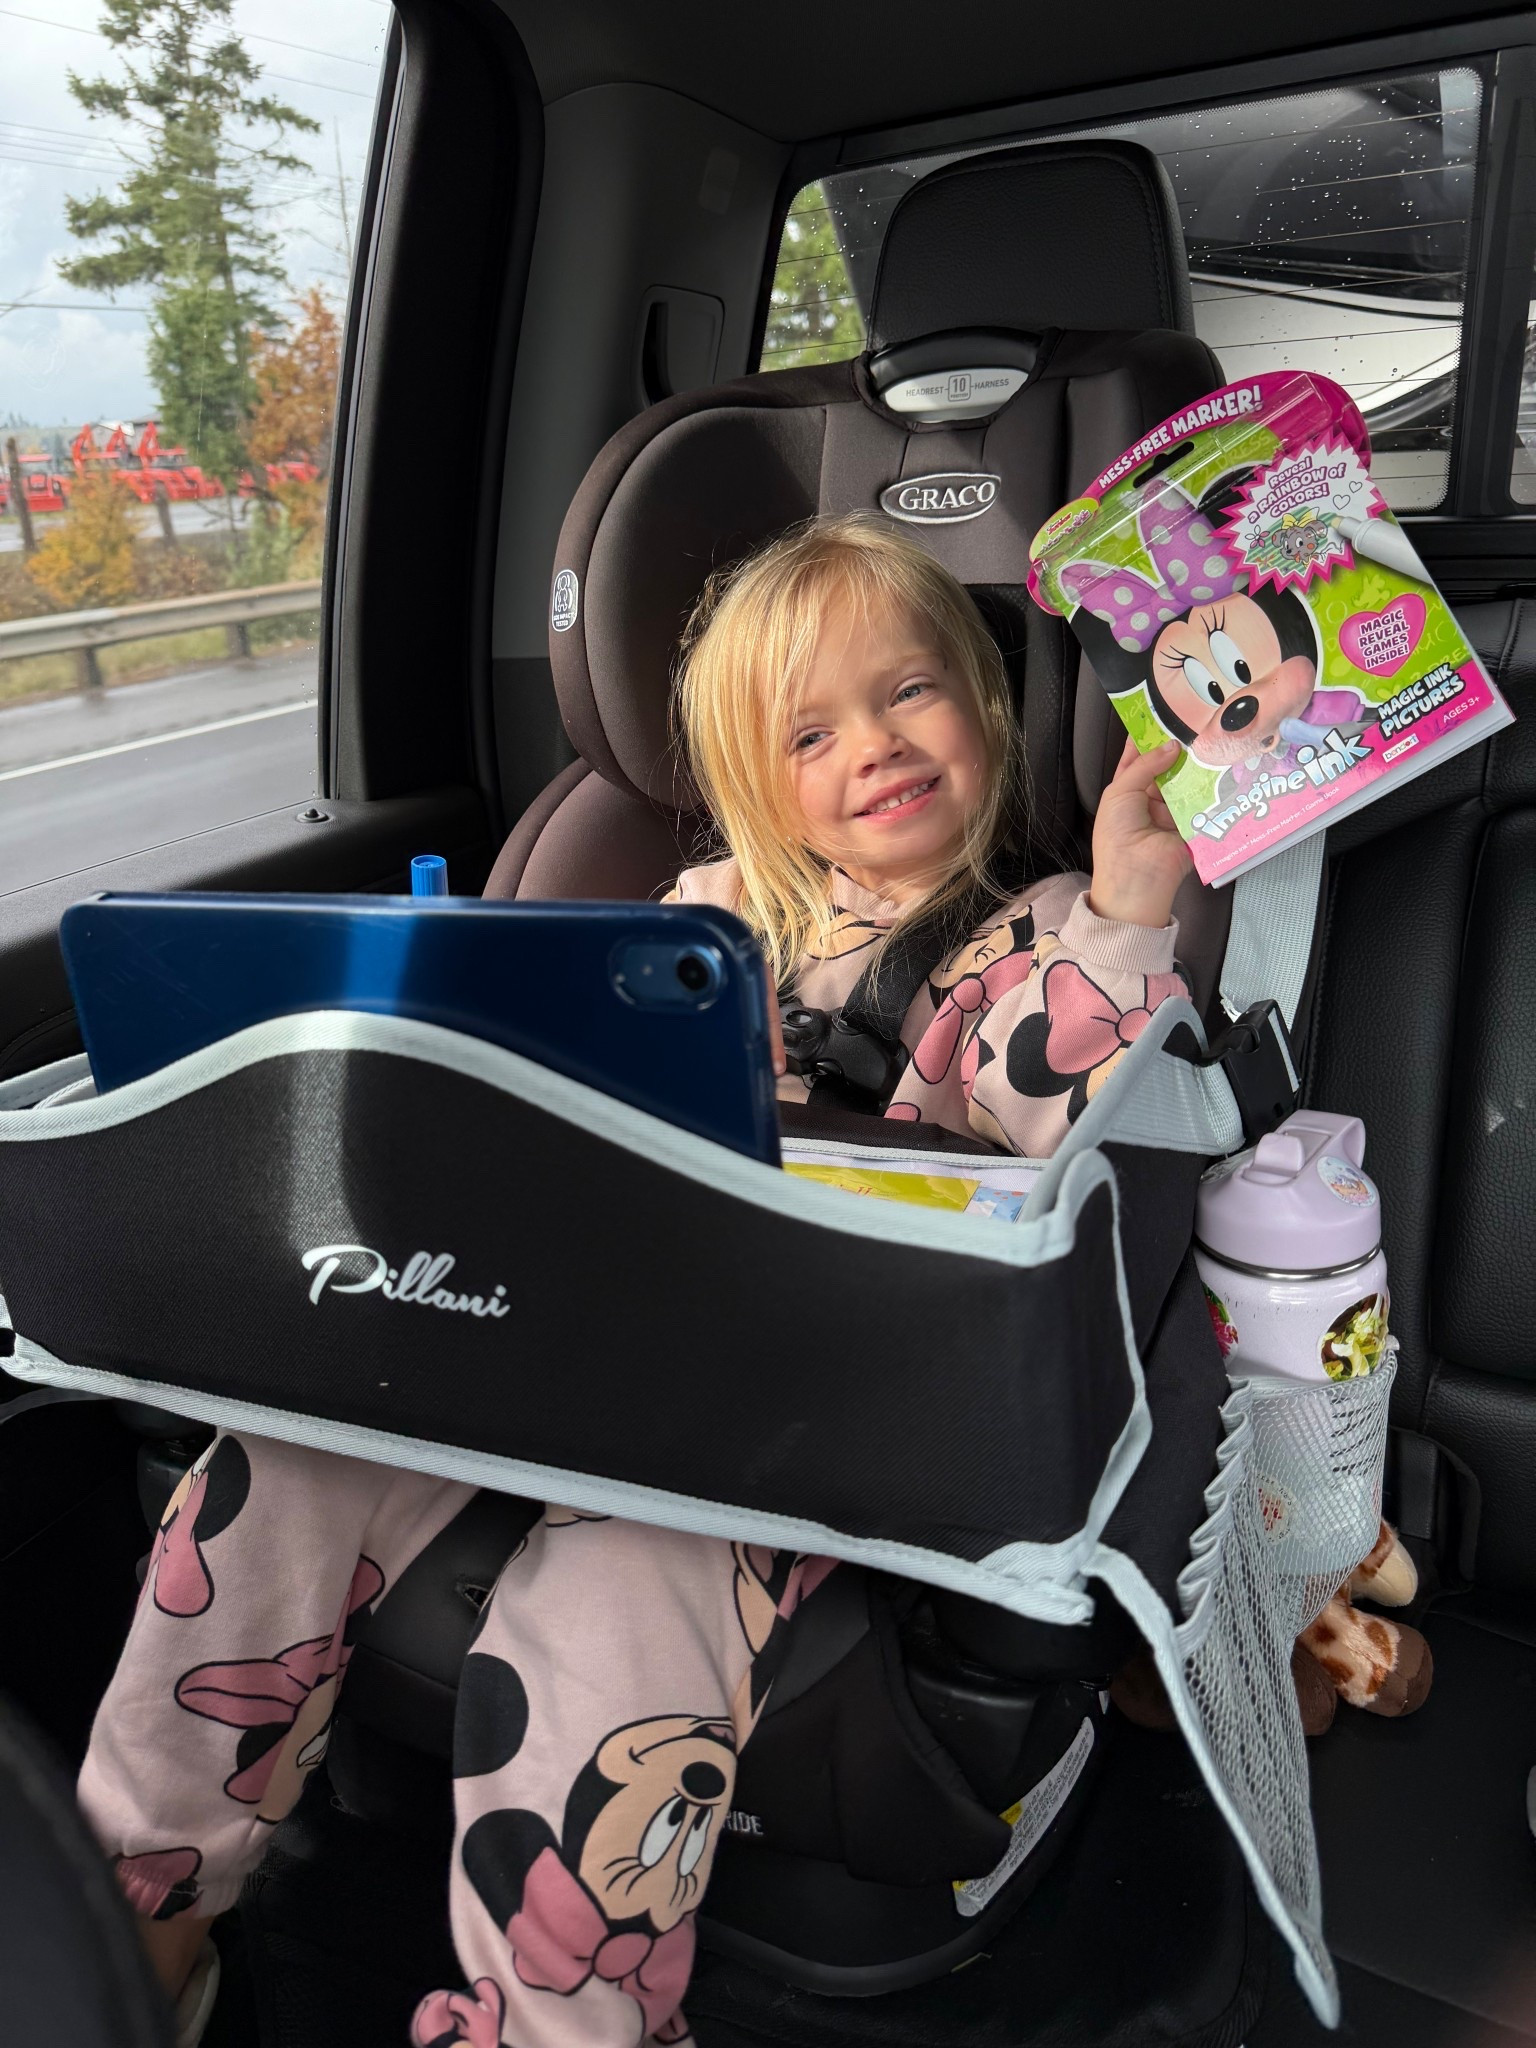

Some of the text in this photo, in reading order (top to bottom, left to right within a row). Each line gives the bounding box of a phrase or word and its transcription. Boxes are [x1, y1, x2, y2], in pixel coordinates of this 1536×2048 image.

[906, 377, 1010, 397] HEADREST 10 HARNESS
[1099, 385, 1263, 489] MESS-FREE MARKER!
[1268, 456, 1313, 489] Reveal
[899, 481, 996, 511] GRACO
[1247, 462, 1347, 524] a RAINBOW of
[1270, 482, 1330, 518] COLORS!
[1358, 620, 1409, 648] REVEAL
[1359, 608, 1404, 635] MAGIC
[1363, 633, 1408, 657] GAMES
[1366, 644, 1409, 669] INSIDE!
[1377, 681, 1425, 720] MAGIC
[1423, 663, 1454, 689] INK
[1381, 674, 1465, 738] PICTURES
[1443, 696, 1480, 723] AGES 3+
[301, 1244, 511, 1318] Pillani
